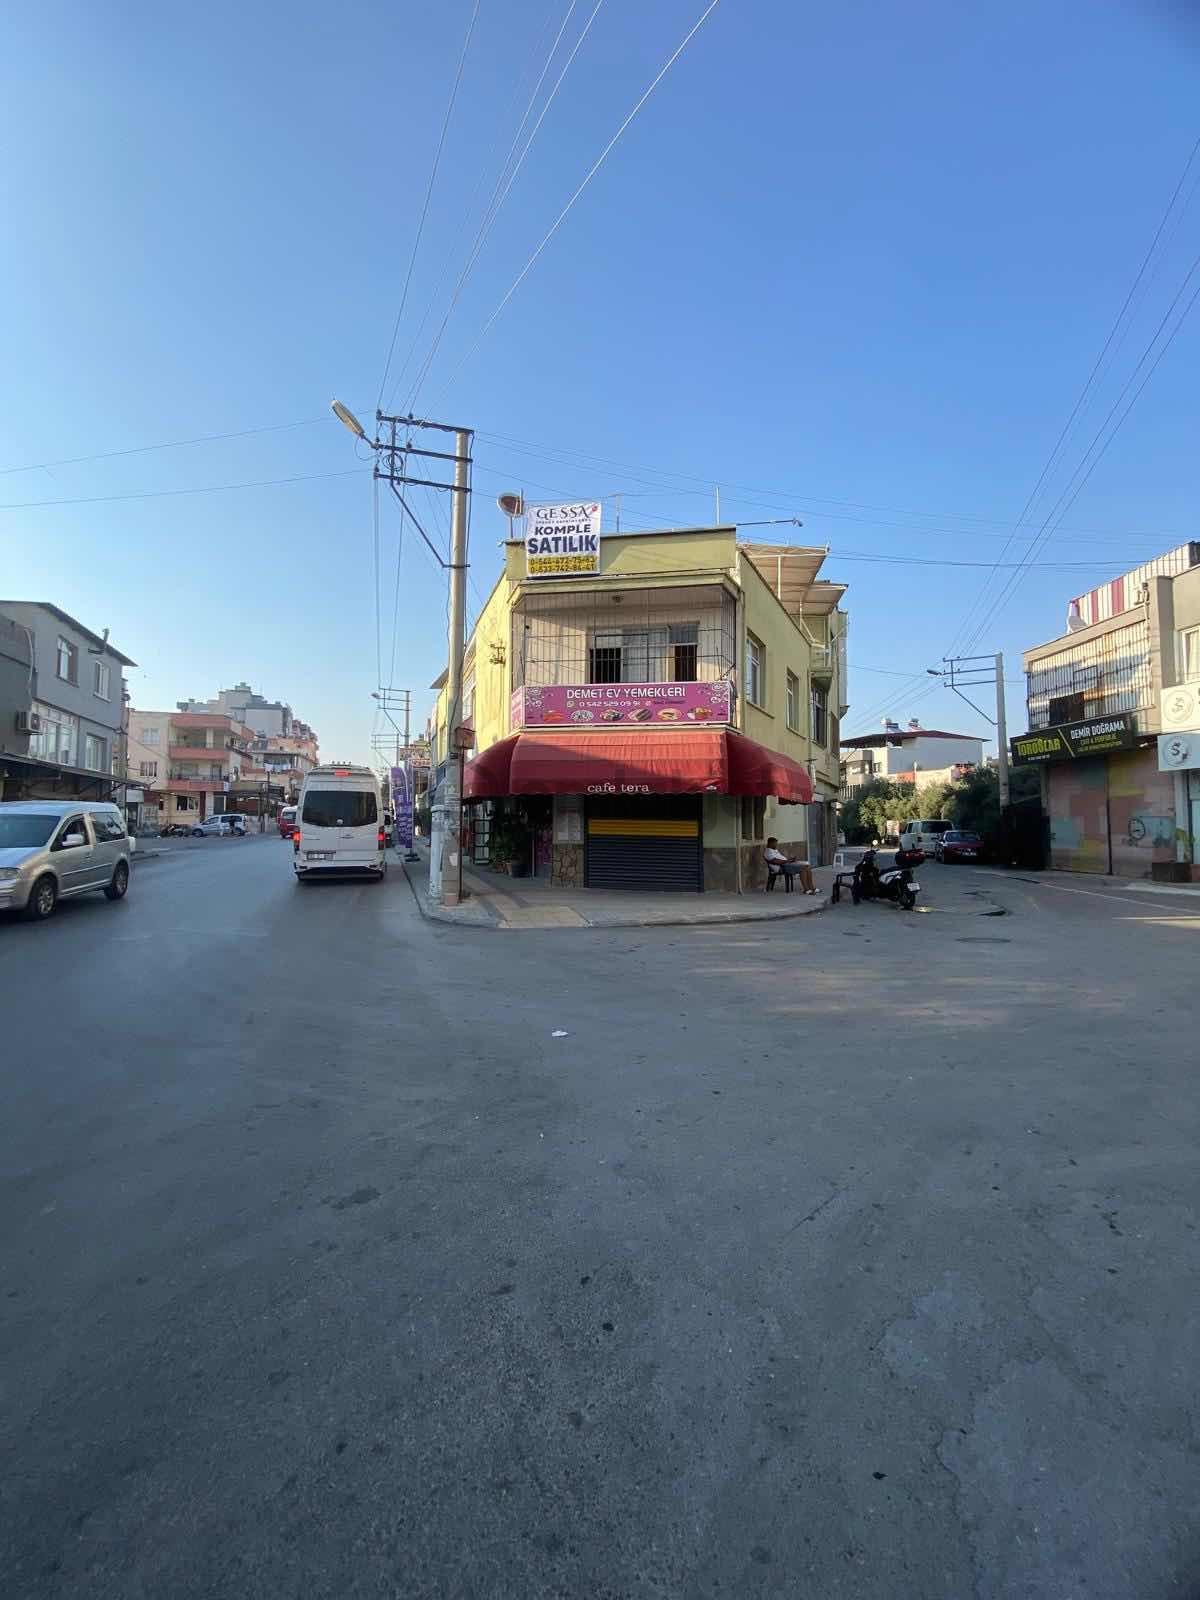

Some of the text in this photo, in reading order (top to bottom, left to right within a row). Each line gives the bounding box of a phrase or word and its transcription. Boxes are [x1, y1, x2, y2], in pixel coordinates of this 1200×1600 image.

[536, 505, 591, 520] GESSA
[534, 524, 591, 535] KOMPLE
[528, 534, 597, 554] SATILIK
[566, 688, 603, 699] DEMET
[606, 688, 621, 698] EV
[1092, 720, 1126, 736] DOĞRAMA
[587, 782, 649, 792] cafe tera
